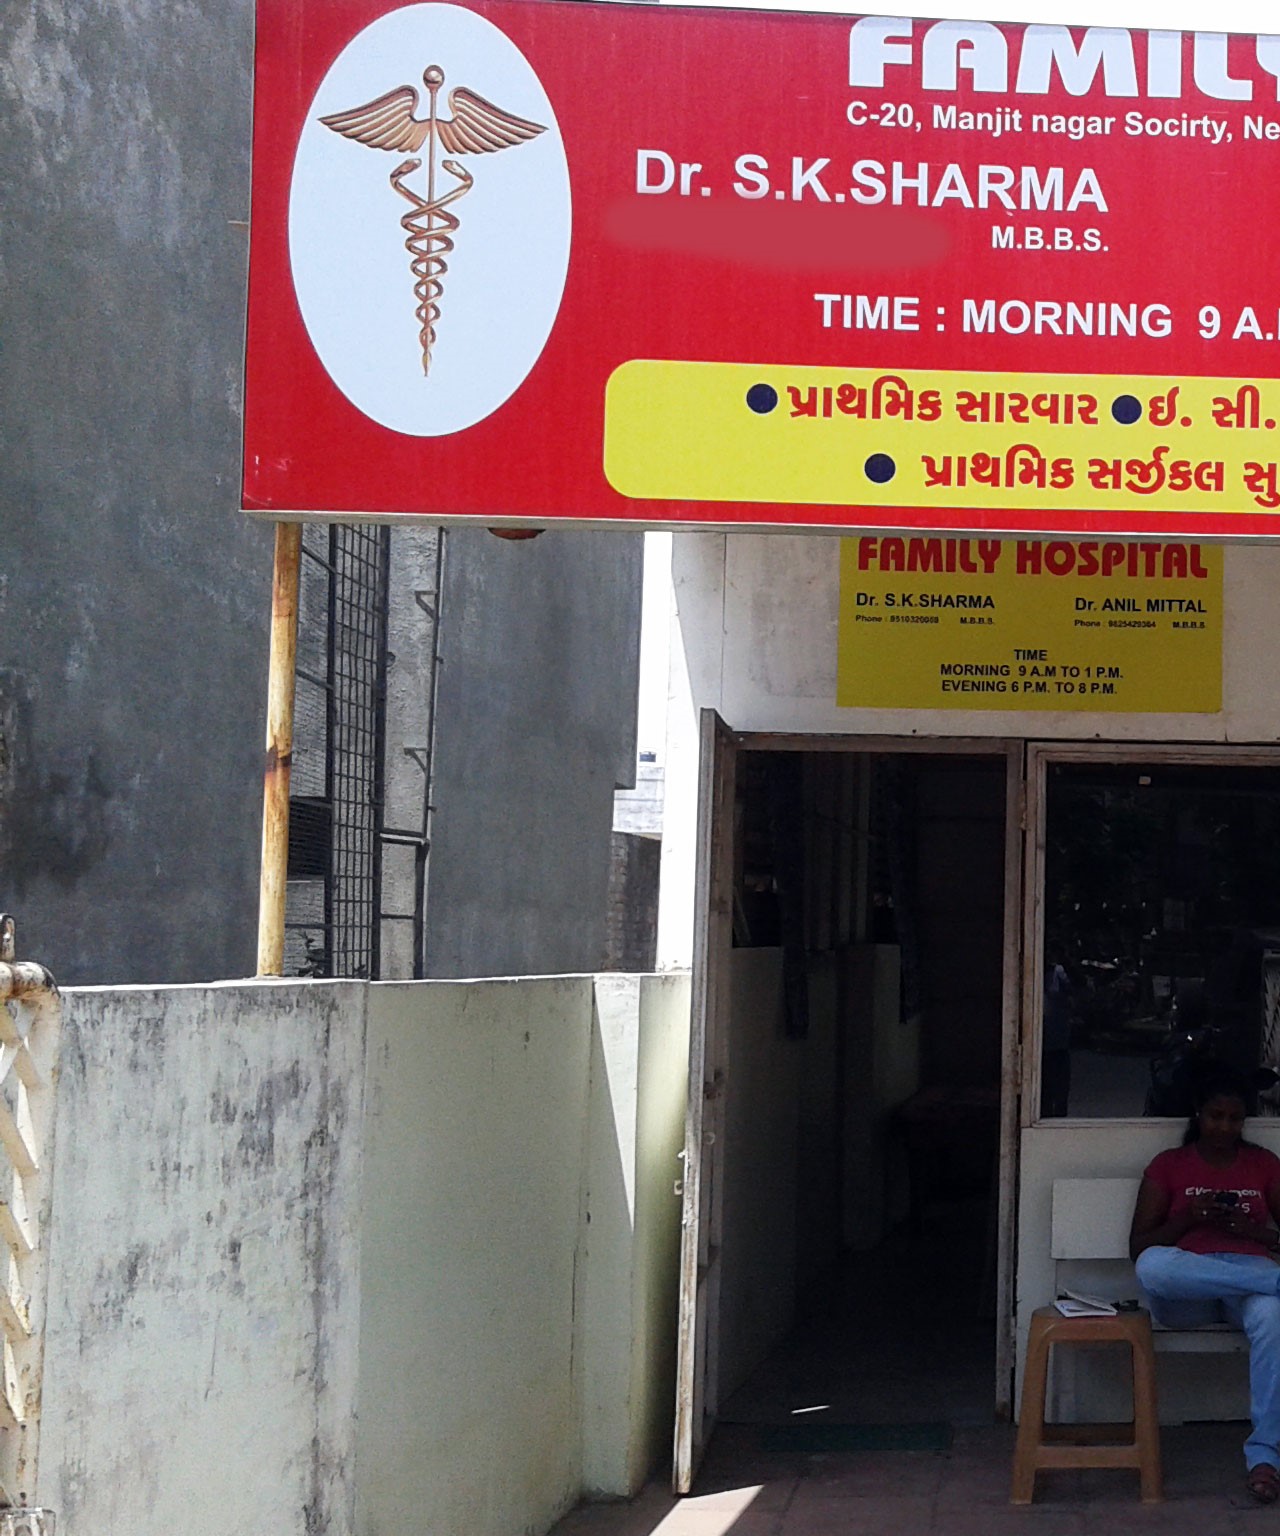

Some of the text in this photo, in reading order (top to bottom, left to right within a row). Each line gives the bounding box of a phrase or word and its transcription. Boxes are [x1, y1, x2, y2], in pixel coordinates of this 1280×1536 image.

[846, 100, 922, 133] C-20,
[932, 104, 1023, 138] Manjit
[1032, 114, 1113, 141] nagar
[1124, 111, 1233, 145] Socirty,
[636, 148, 1109, 214] Dr. S.K.SHARMA
[991, 225, 1109, 252] M.B.B.S.
[813, 293, 920, 331] TIME
[962, 298, 1172, 338] MORNING
[1198, 305, 1221, 340] 9
[786, 375, 943, 422] પ્રાથમિક
[955, 391, 1099, 425] સારવાર
[1211, 384, 1276, 430] સી.
[921, 443, 1075, 489] પ્રાથમિક
[858, 537, 1208, 579] FAMILY HOSPITAL
[856, 592, 996, 609] Dr. S.K.SHARMA
[1075, 597, 1207, 613] Dr. ANIL MITTAL
[855, 614, 883, 623] Phone
[1074, 619, 1101, 628] Phone
[1013, 648, 1048, 662] TIME
[940, 663, 1124, 679] MORNING 9 A.M TO 1 P.M.
[941, 679, 1117, 695] EVENING 6 P.M. TO 8 P.M.
